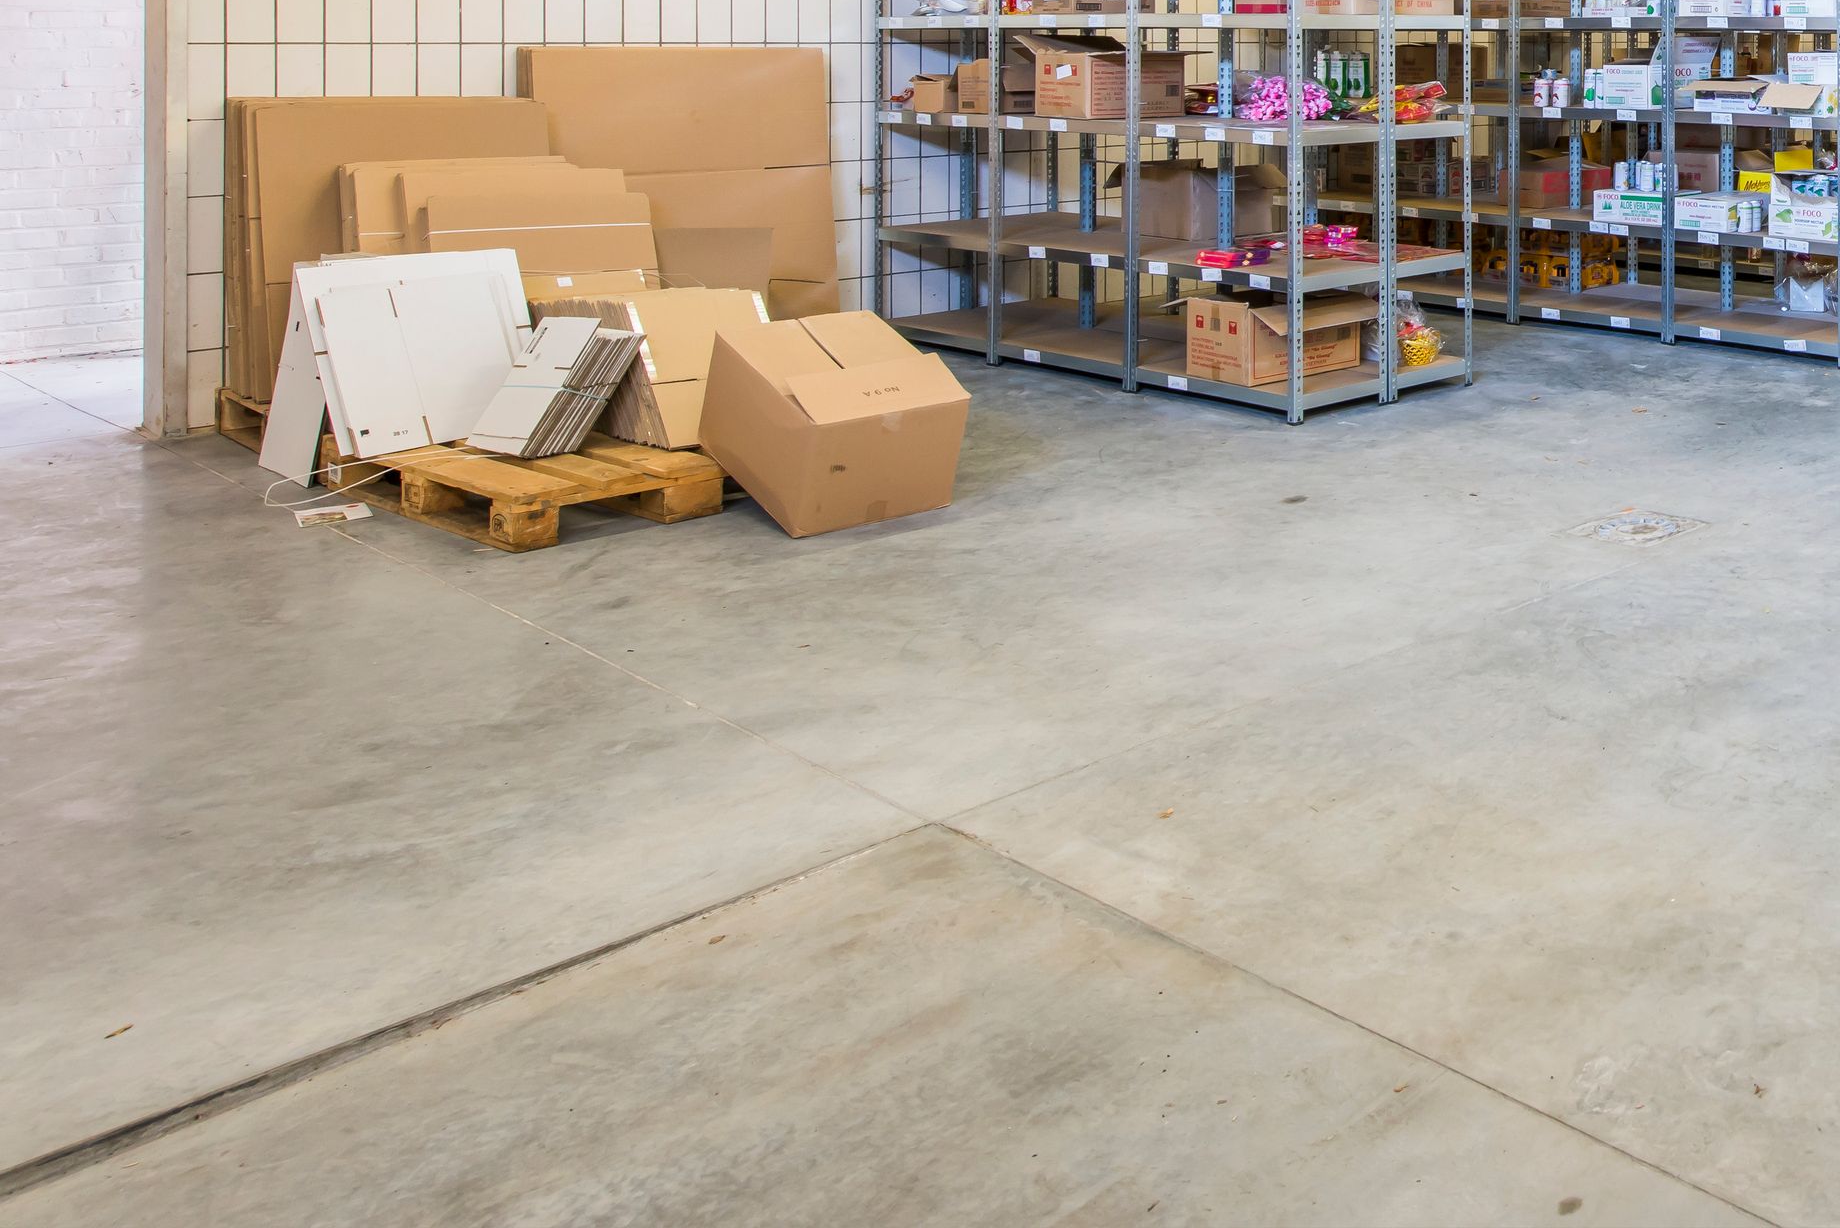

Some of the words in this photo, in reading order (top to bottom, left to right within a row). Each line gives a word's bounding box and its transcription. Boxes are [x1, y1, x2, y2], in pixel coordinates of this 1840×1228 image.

[1675, 68, 1691, 77] OCO
[1620, 201, 1633, 209] ALOE
[1633, 202, 1646, 210] VERA
[1645, 202, 1662, 211] DRINK
[1682, 200, 1698, 208] FOCO
[1802, 209, 1822, 218] FOCO
